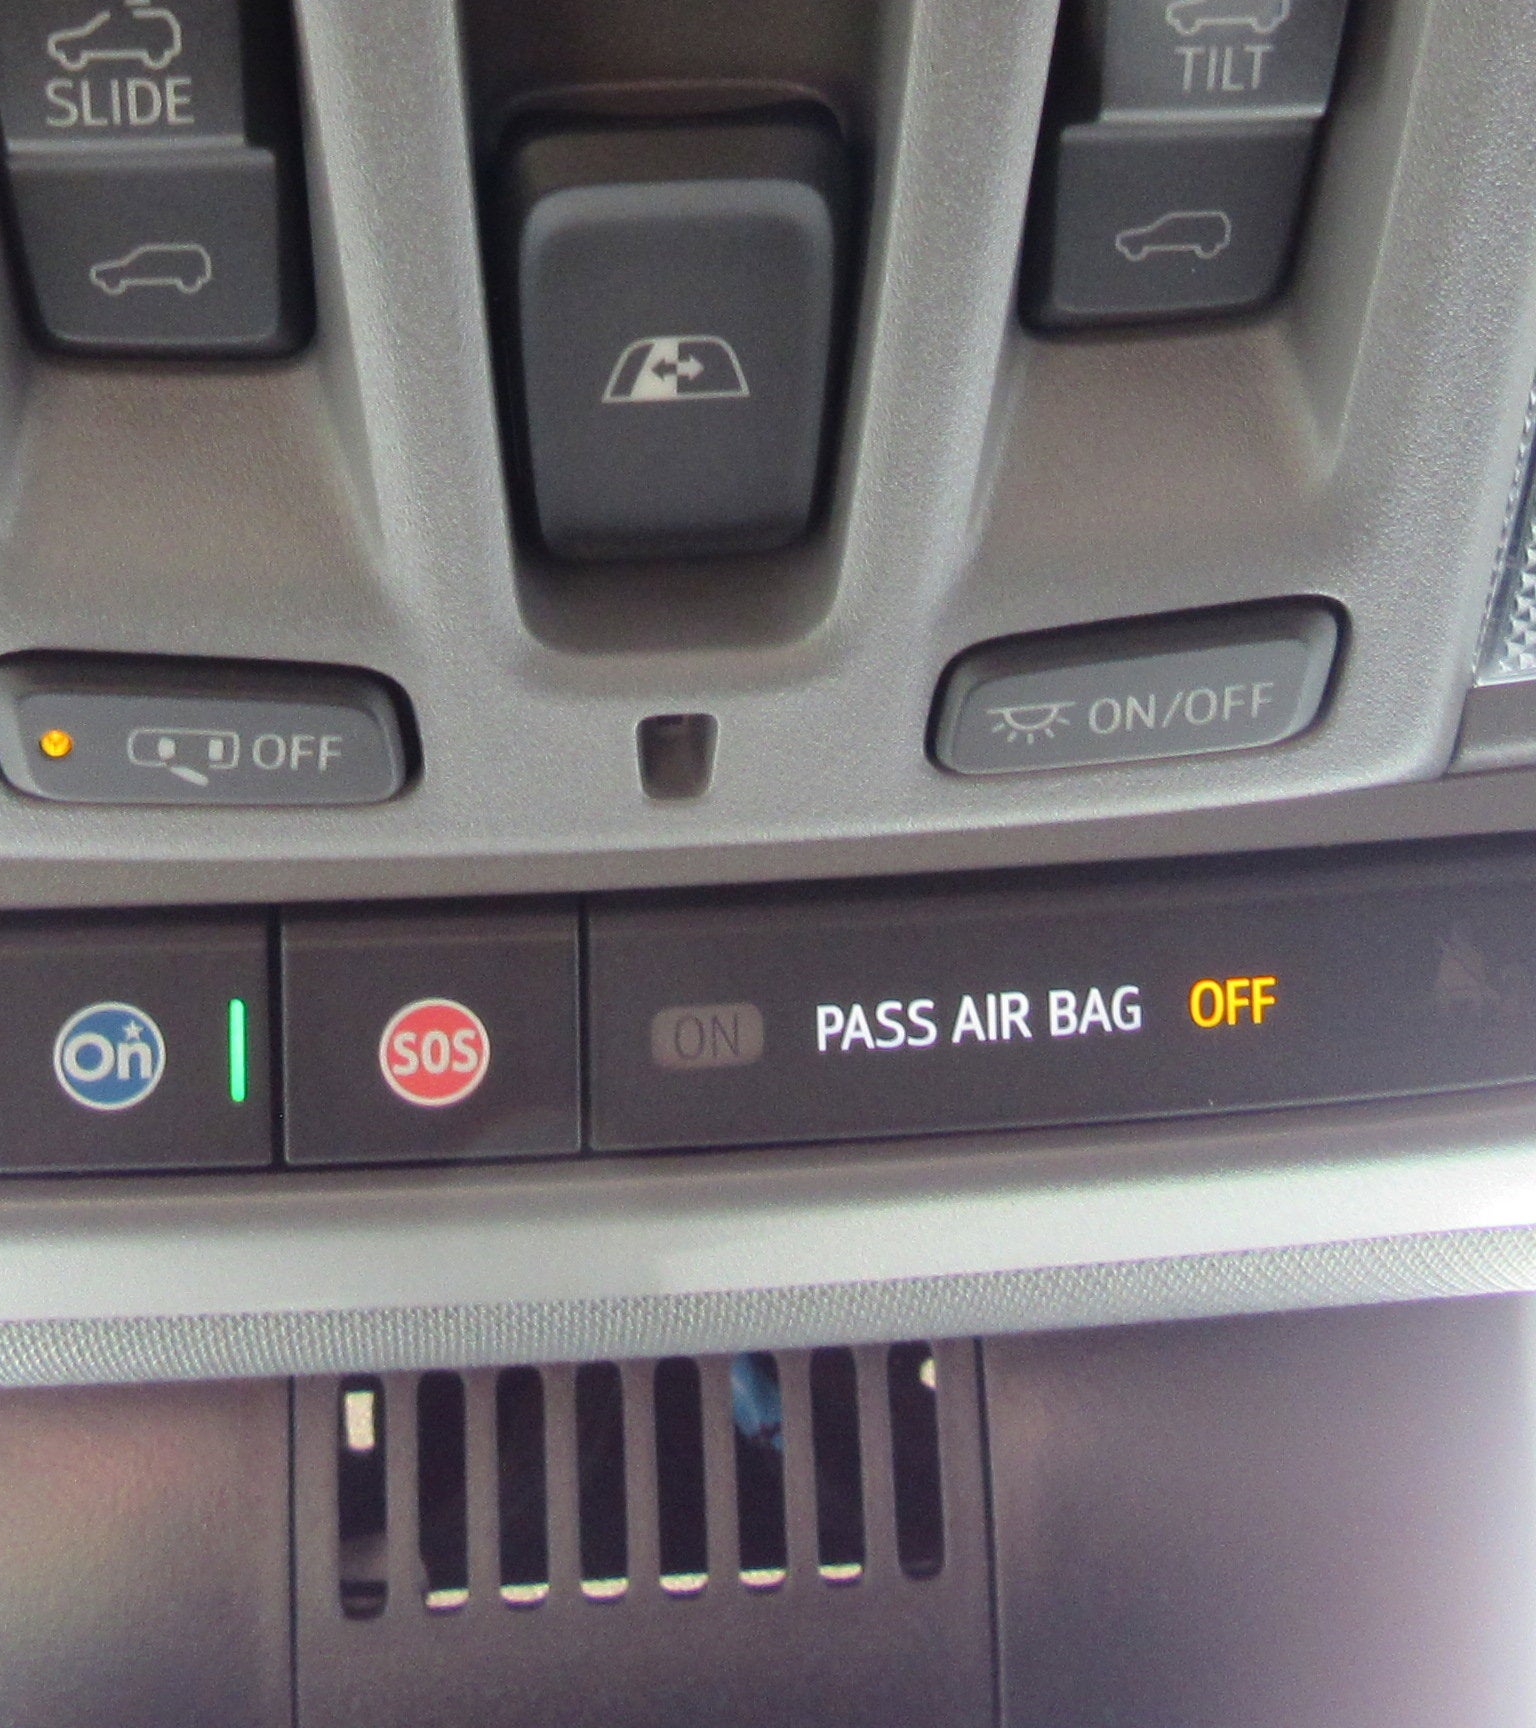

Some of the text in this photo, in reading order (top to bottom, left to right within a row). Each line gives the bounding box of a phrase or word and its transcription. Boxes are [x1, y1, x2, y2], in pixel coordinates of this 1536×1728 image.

[1175, 45, 1274, 92] TILT
[45, 76, 196, 128] SLIDE
[1088, 682, 1275, 735] ON/OFF
[252, 733, 344, 772] OFF
[672, 977, 1277, 1060] ON PASS AIR BAG OFF
[64, 1034, 154, 1083] On
[391, 1028, 480, 1077] SOS
